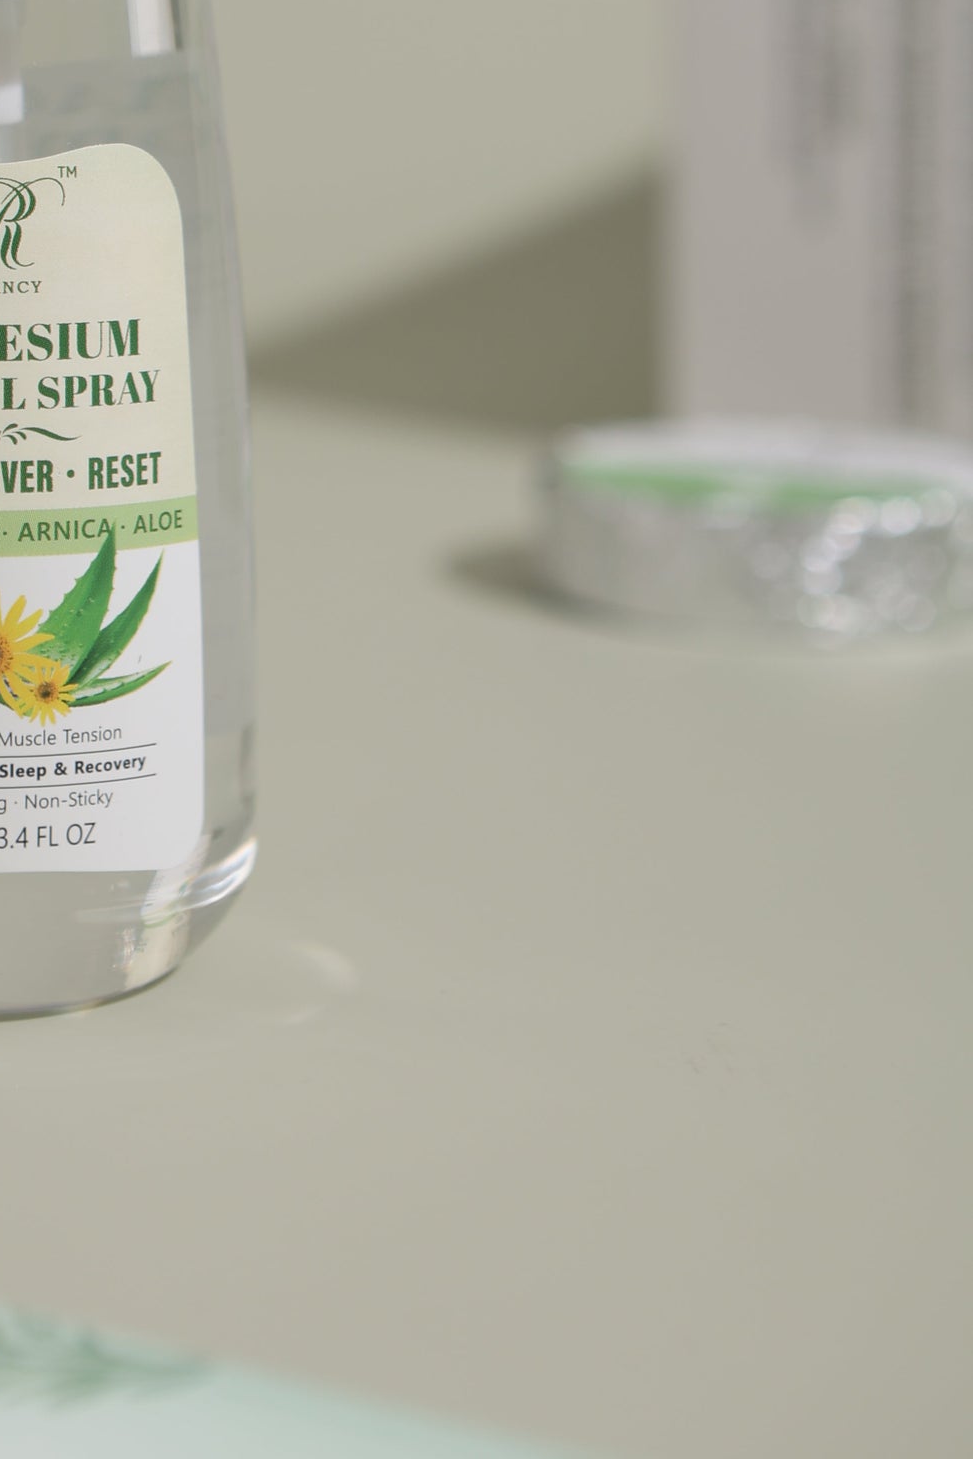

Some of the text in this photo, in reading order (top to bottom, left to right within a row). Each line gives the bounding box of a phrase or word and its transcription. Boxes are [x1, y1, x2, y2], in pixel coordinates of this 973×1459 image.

[57, 166, 77, 178] TM
[37, 370, 160, 409] SPRAY
[88, 452, 161, 489] RESET
[18, 518, 111, 541] ARNICA
[134, 510, 183, 534] ALOE
[63, 726, 122, 745] Tension
[0, 762, 47, 781] Sleep
[54, 762, 67, 776] &
[75, 756, 146, 774] Recovery
[24, 790, 113, 810] Non-Sticky
[36, 825, 58, 847] FL
[66, 822, 96, 844] OZ
